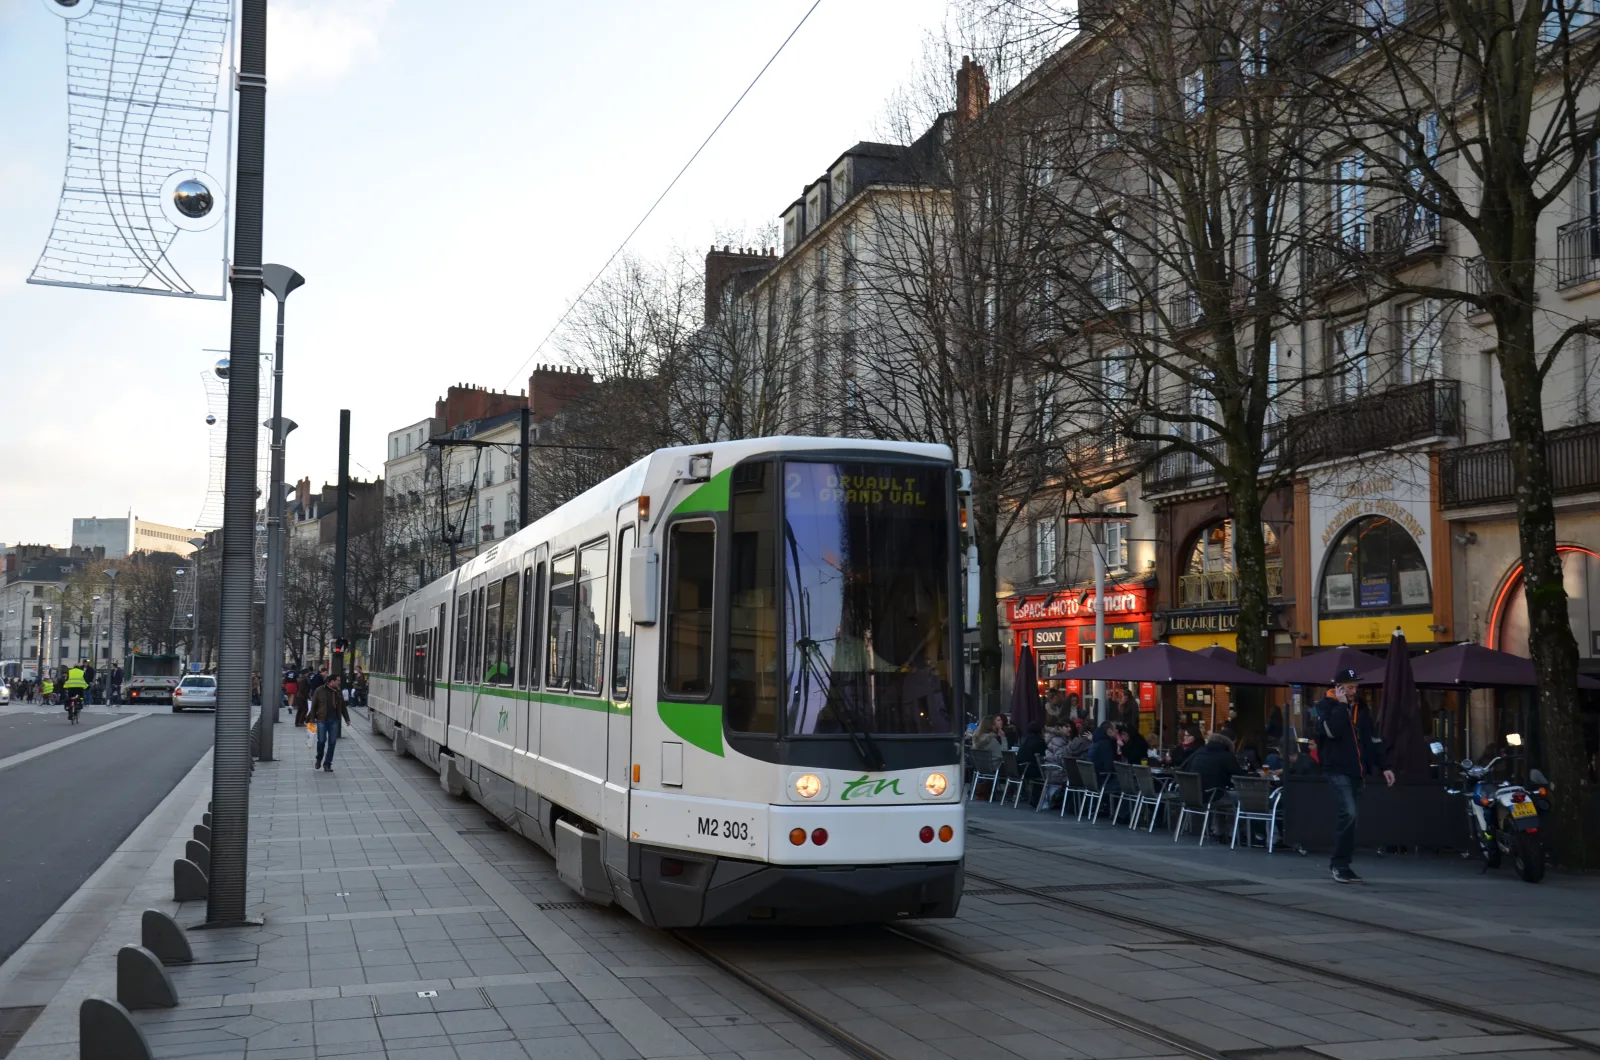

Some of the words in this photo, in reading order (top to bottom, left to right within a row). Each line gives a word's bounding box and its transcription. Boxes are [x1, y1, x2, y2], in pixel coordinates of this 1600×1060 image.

[786, 472, 802, 498] 2
[819, 489, 884, 504] GRAND
[889, 491, 927, 505] VAL
[1013, 602, 1047, 619] ESPACE
[1048, 598, 1079, 617] PHOTO
[1036, 631, 1063, 643] SONY
[1113, 626, 1134, 639] Nikon
[840, 775, 904, 800] tan
[698, 816, 719, 837] M2
[723, 820, 749, 841] 303
